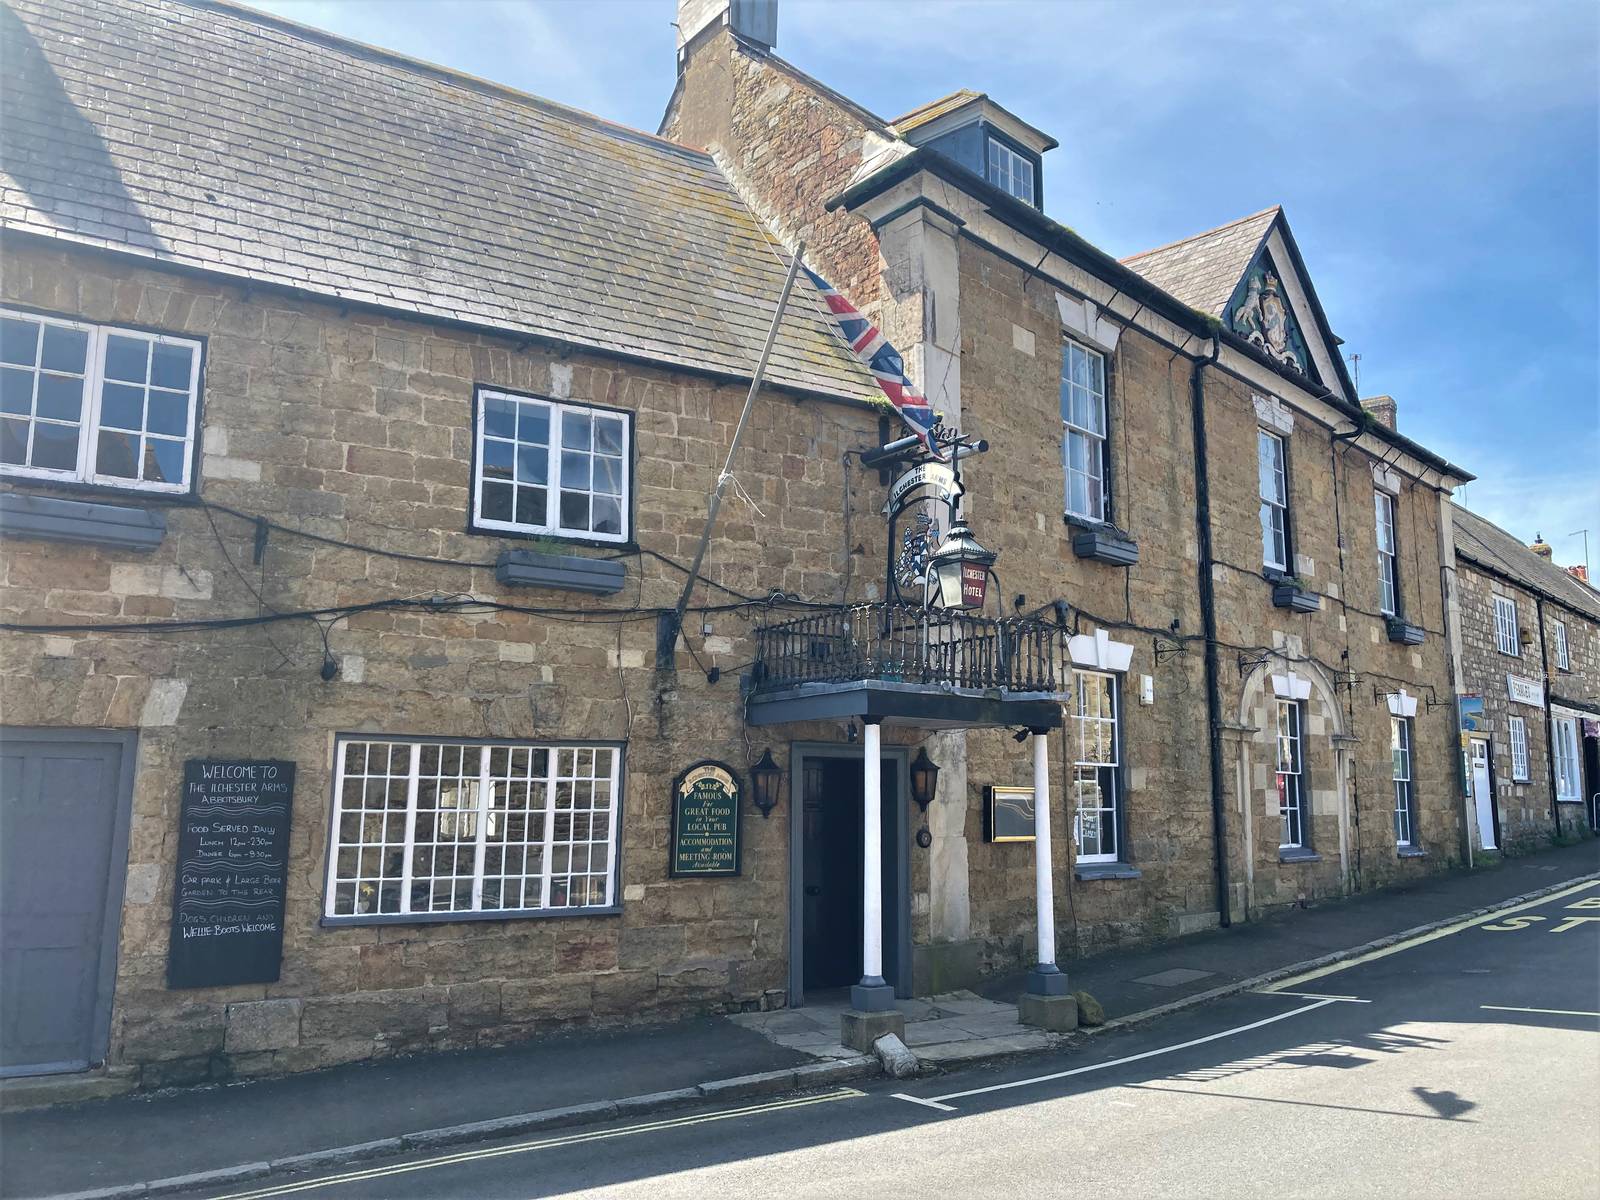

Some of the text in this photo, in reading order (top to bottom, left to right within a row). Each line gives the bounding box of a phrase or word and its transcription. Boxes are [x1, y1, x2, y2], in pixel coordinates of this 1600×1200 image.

[915, 464, 926, 474] THE
[893, 473, 948, 499] ILCHESTER ARMS
[963, 583, 983, 597] HOTEL
[202, 764, 278, 779] WELCOME TO
[189, 782, 289, 794] THE ILCHESTER ARMS
[201, 795, 260, 805] ABBOTSBURY
[693, 792, 721, 800] FAMOUS
[684, 807, 730, 816] GREAT FOOD
[187, 822, 209, 833] FOOD
[212, 822, 249, 834] SERVED
[687, 823, 727, 831] LOCAL PUB
[200, 837, 224, 846] LUNCH
[680, 838, 733, 846] ACCOMMODATION
[679, 852, 732, 861] MEETING ROOM
[182, 874, 197, 885] CAR
[235, 874, 260, 885] LARGE
[181, 888, 213, 897] GARDEN
[253, 888, 274, 896] REAR
[183, 922, 278, 939] WELLIE BOOTS WELCOME
